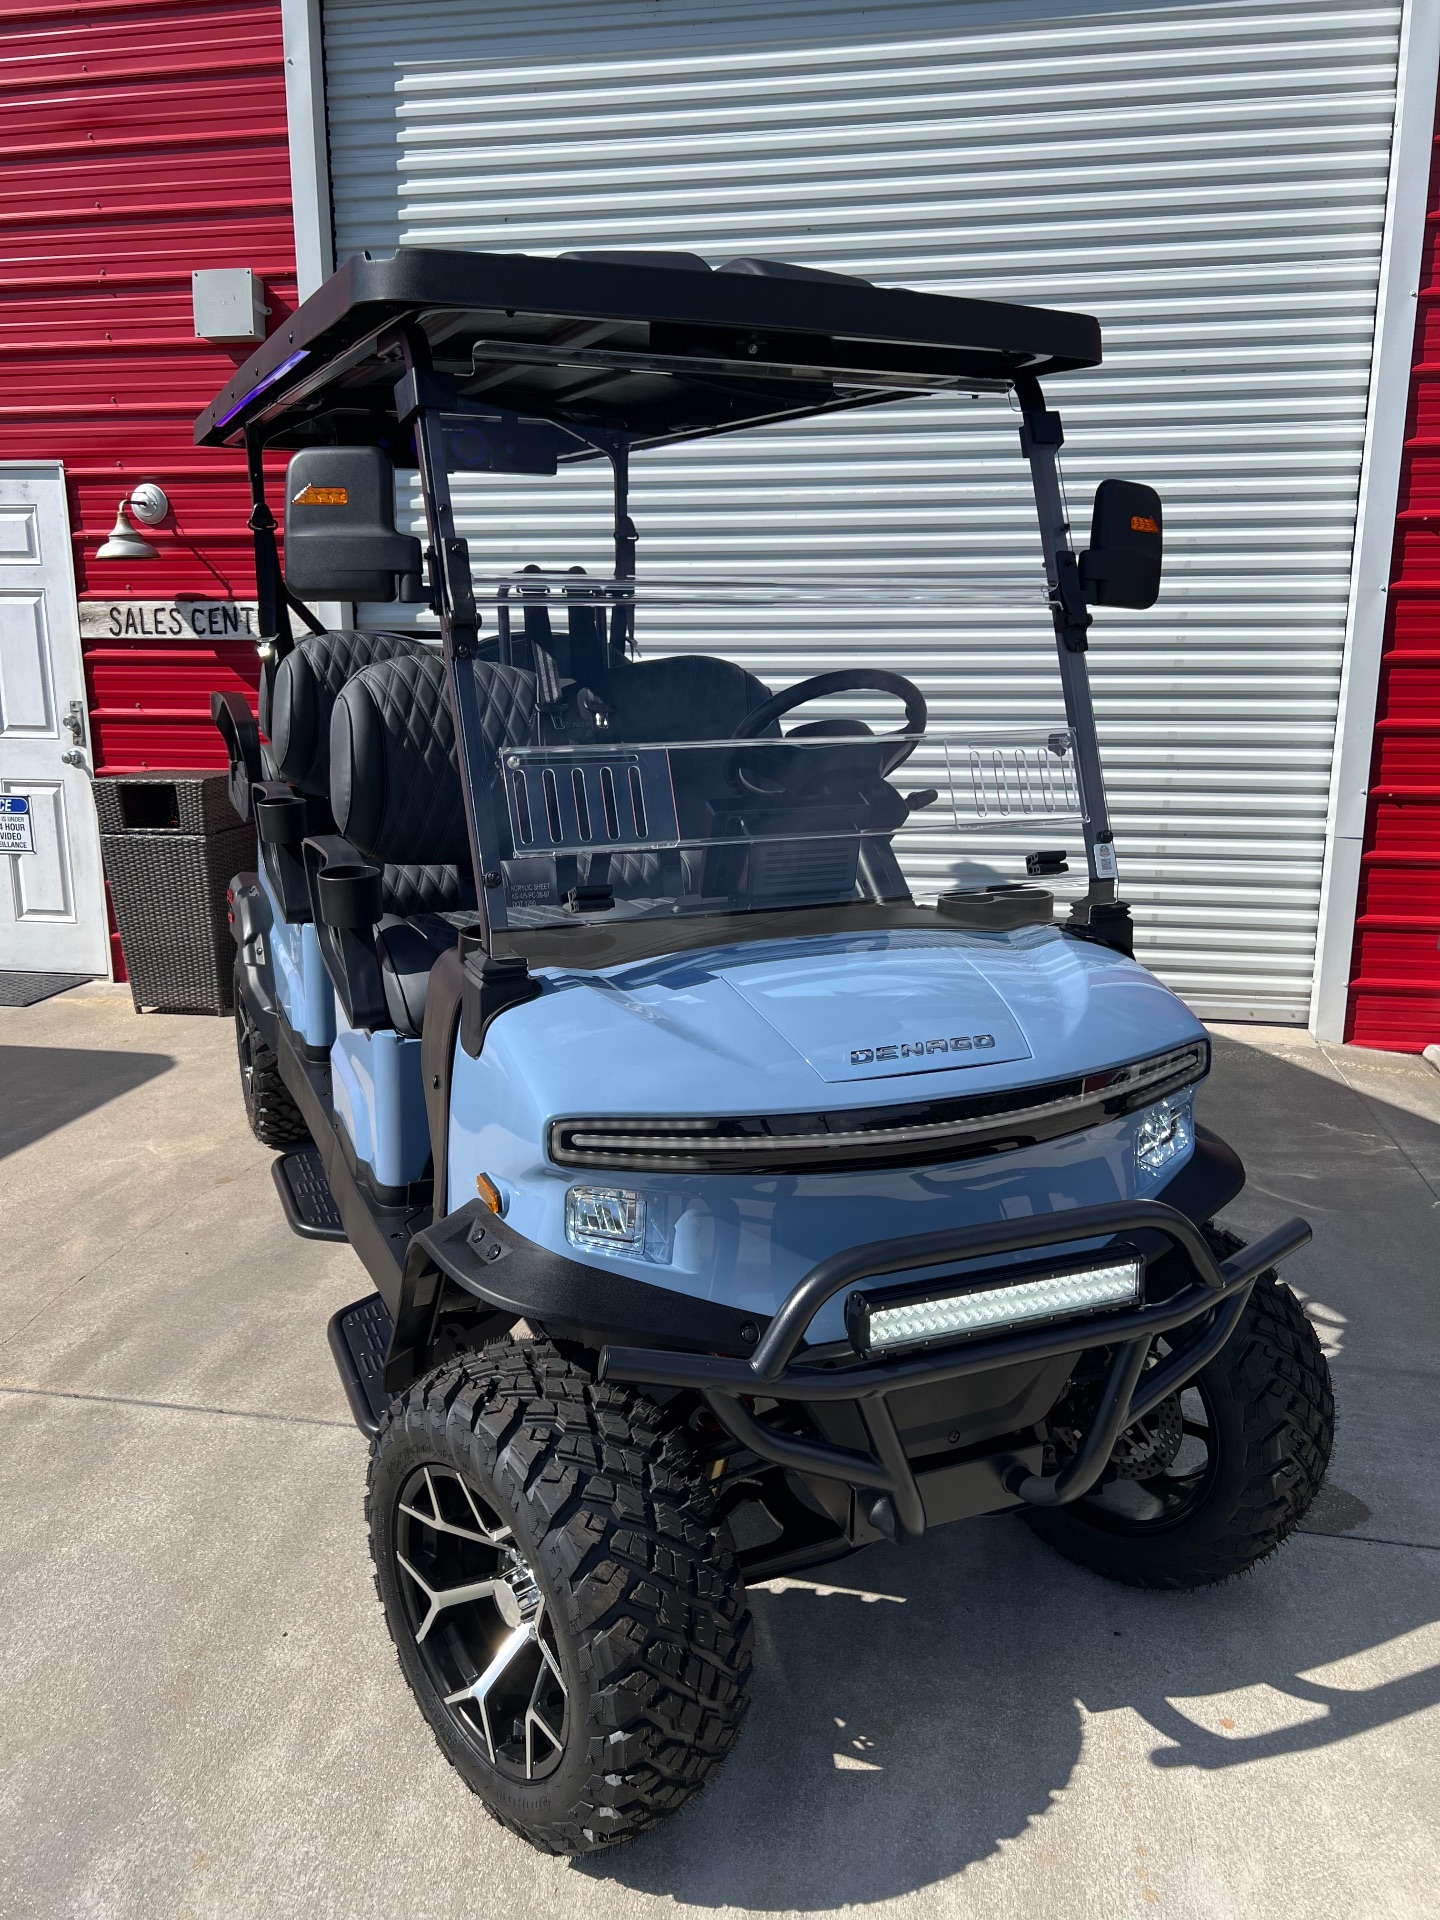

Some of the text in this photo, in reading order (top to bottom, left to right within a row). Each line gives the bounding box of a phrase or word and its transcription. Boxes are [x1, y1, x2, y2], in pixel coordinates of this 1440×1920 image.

[109, 605, 255, 637] SALES CENT
[5, 823, 26, 832] HOUR
[0, 832, 22, 841] VIDEO
[510, 882, 551, 892] ACRYLIC SHEET
[850, 1034, 996, 1066] DENAGO
